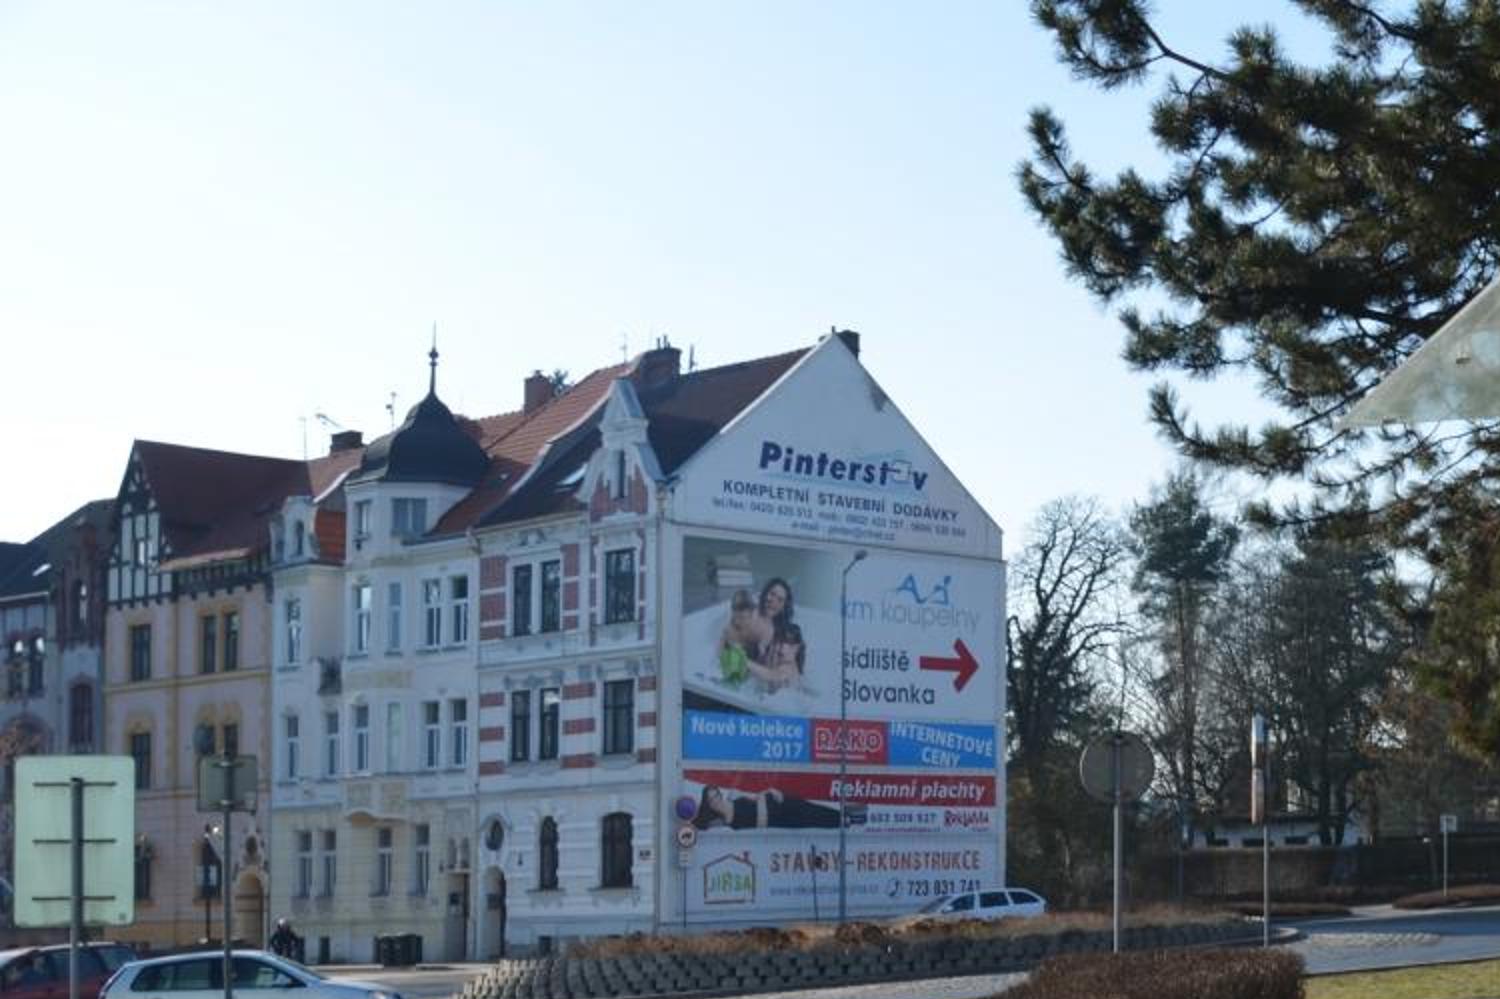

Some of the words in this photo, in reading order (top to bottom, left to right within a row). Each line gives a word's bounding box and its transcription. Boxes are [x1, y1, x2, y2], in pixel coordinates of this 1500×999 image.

[842, 646, 909, 671] sídliště
[842, 679, 935, 704] Slovanka
[690, 716, 735, 737] Nové
[739, 718, 803, 739] kolekce
[891, 720, 993, 757] INTERNETOVÉ
[762, 740, 803, 759] 2017
[815, 727, 882, 753] RAKO
[921, 746, 961, 768] CENY
[921, 779, 985, 801] plachty
[857, 851, 980, 872] REKONSTRUKCE
